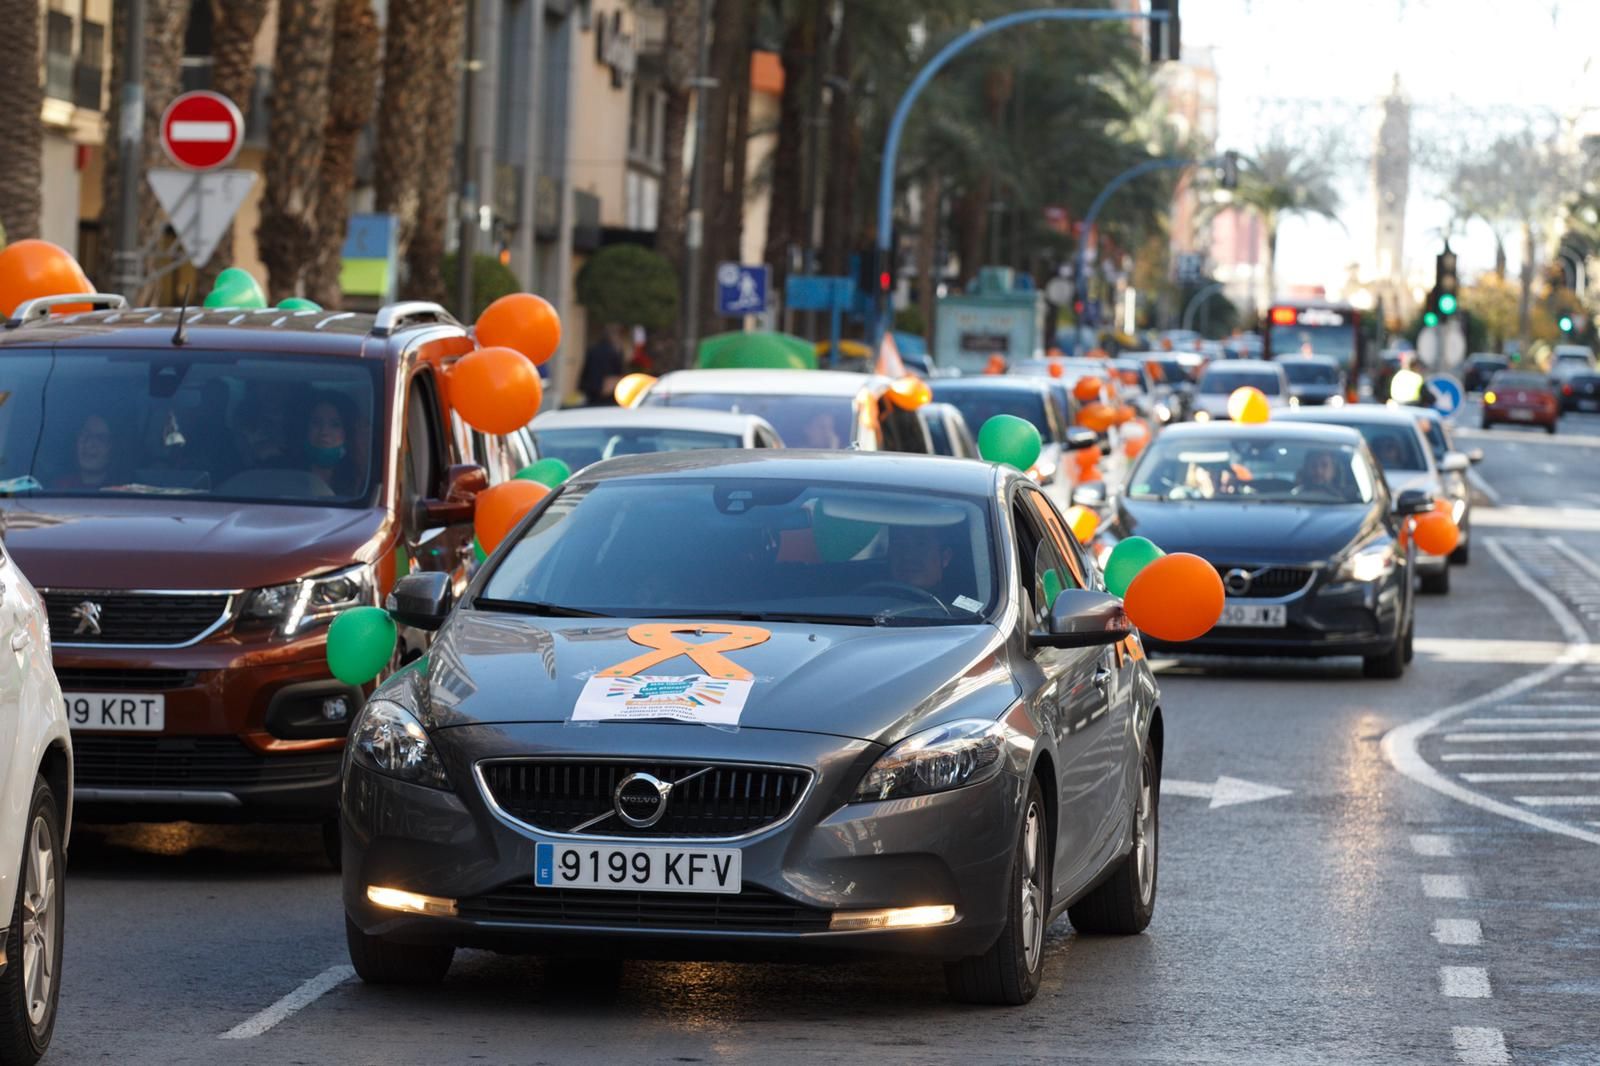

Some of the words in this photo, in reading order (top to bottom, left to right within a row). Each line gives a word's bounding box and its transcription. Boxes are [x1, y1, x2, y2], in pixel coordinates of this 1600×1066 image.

[101, 698, 155, 725] KRT
[621, 796, 658, 804] VOLVO
[541, 868, 549, 878] E
[560, 849, 651, 884] 9199
[664, 853, 732, 886] KFV
